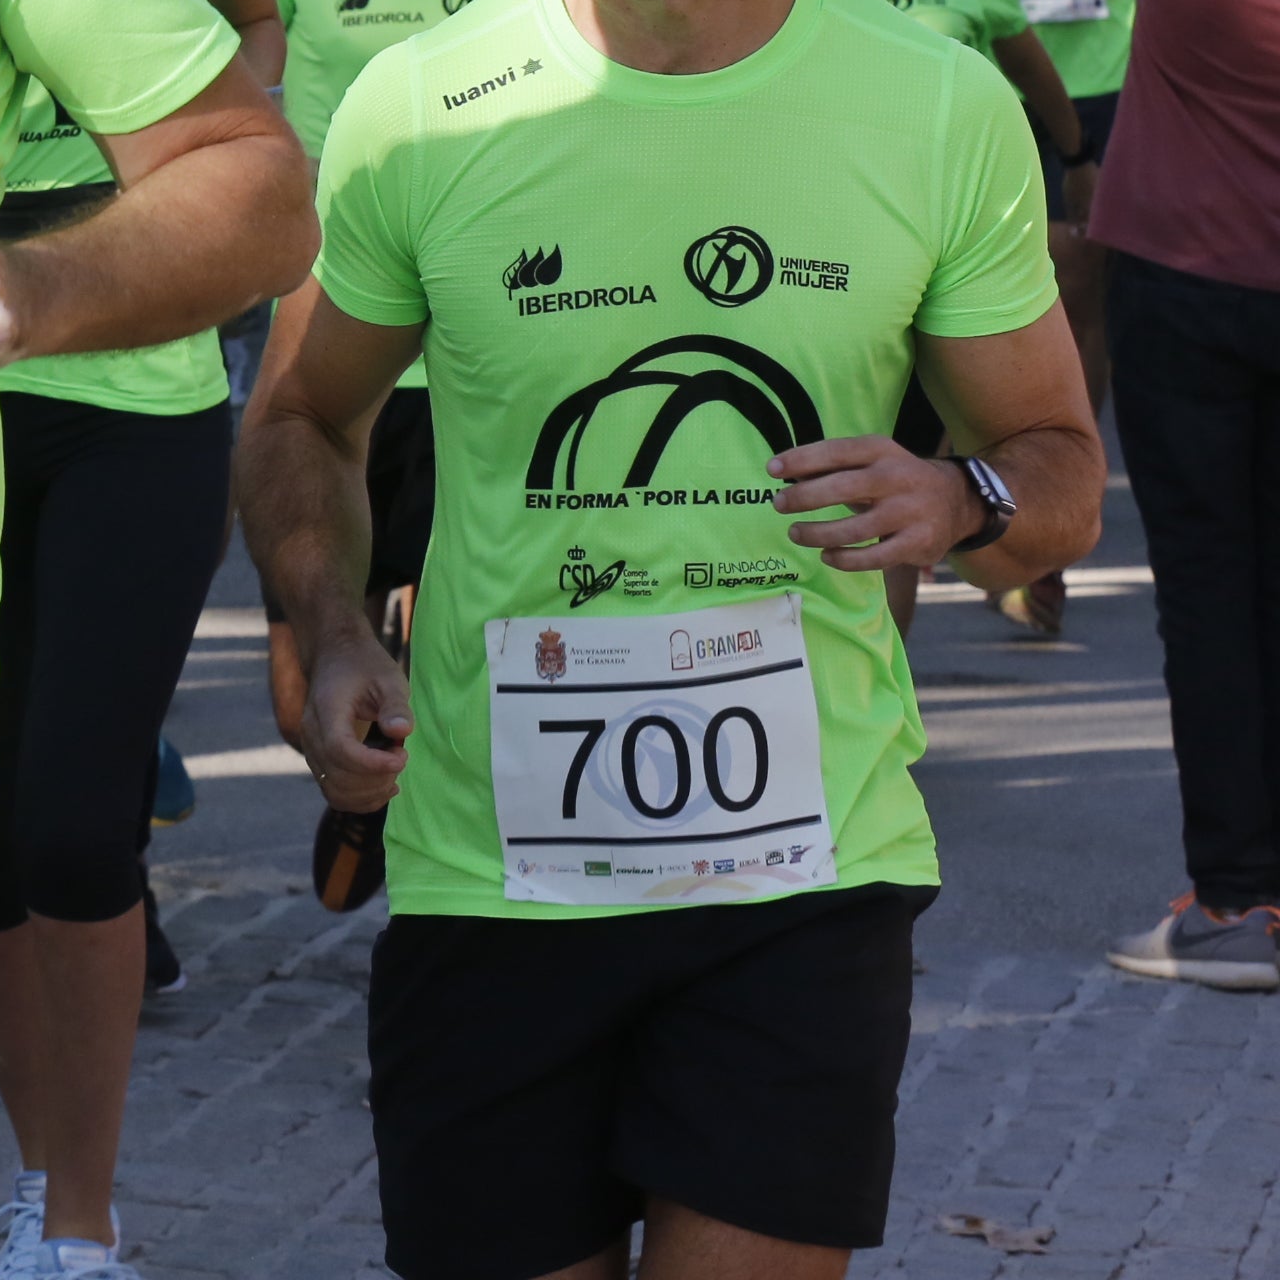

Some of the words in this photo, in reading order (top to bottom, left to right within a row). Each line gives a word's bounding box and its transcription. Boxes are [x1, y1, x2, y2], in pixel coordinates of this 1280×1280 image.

[443, 66, 517, 111] luanvi
[19, 126, 82, 143] UALDAD
[779, 256, 850, 276] UNIVERSO
[779, 271, 849, 292] MUJER
[518, 284, 657, 317] IBERDROLA
[525, 493, 551, 509] EN
[556, 492, 629, 510] FORMA
[692, 489, 720, 505] LA
[725, 488, 780, 505] IGUA
[623, 569, 648, 579] Consejo
[718, 556, 787, 575] FUNDACIÓN
[623, 579, 649, 588] Superior
[650, 579, 659, 587] de
[623, 588, 652, 597] Deportes
[696, 629, 763, 660] GRANADA
[538, 706, 769, 820] 700
